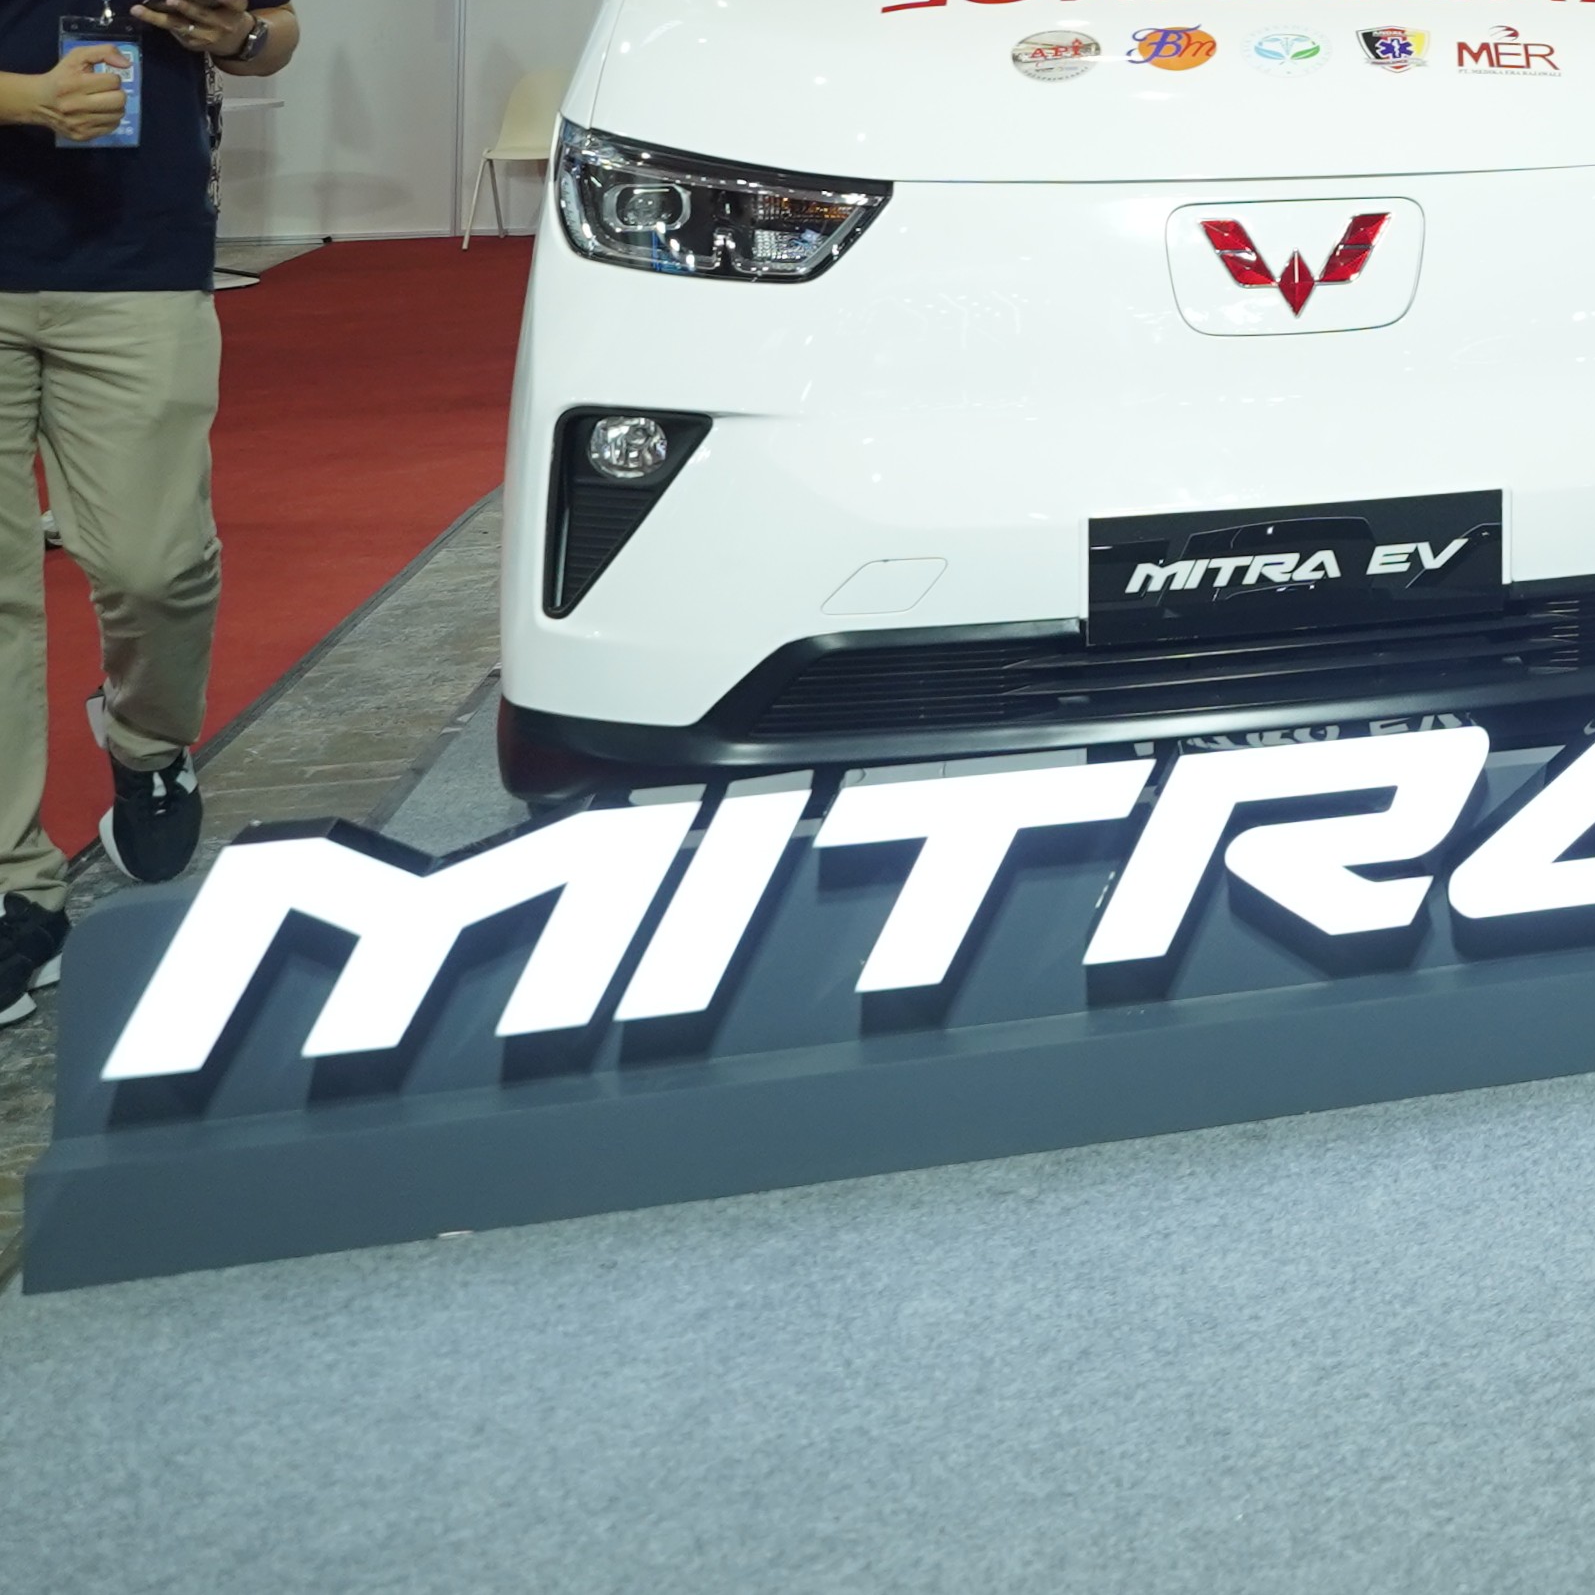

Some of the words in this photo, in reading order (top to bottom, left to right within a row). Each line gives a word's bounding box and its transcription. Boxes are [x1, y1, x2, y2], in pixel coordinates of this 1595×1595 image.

[1457, 42, 1560, 70] MER
[1125, 550, 1341, 594] MITRA
[1366, 538, 1468, 575] EV
